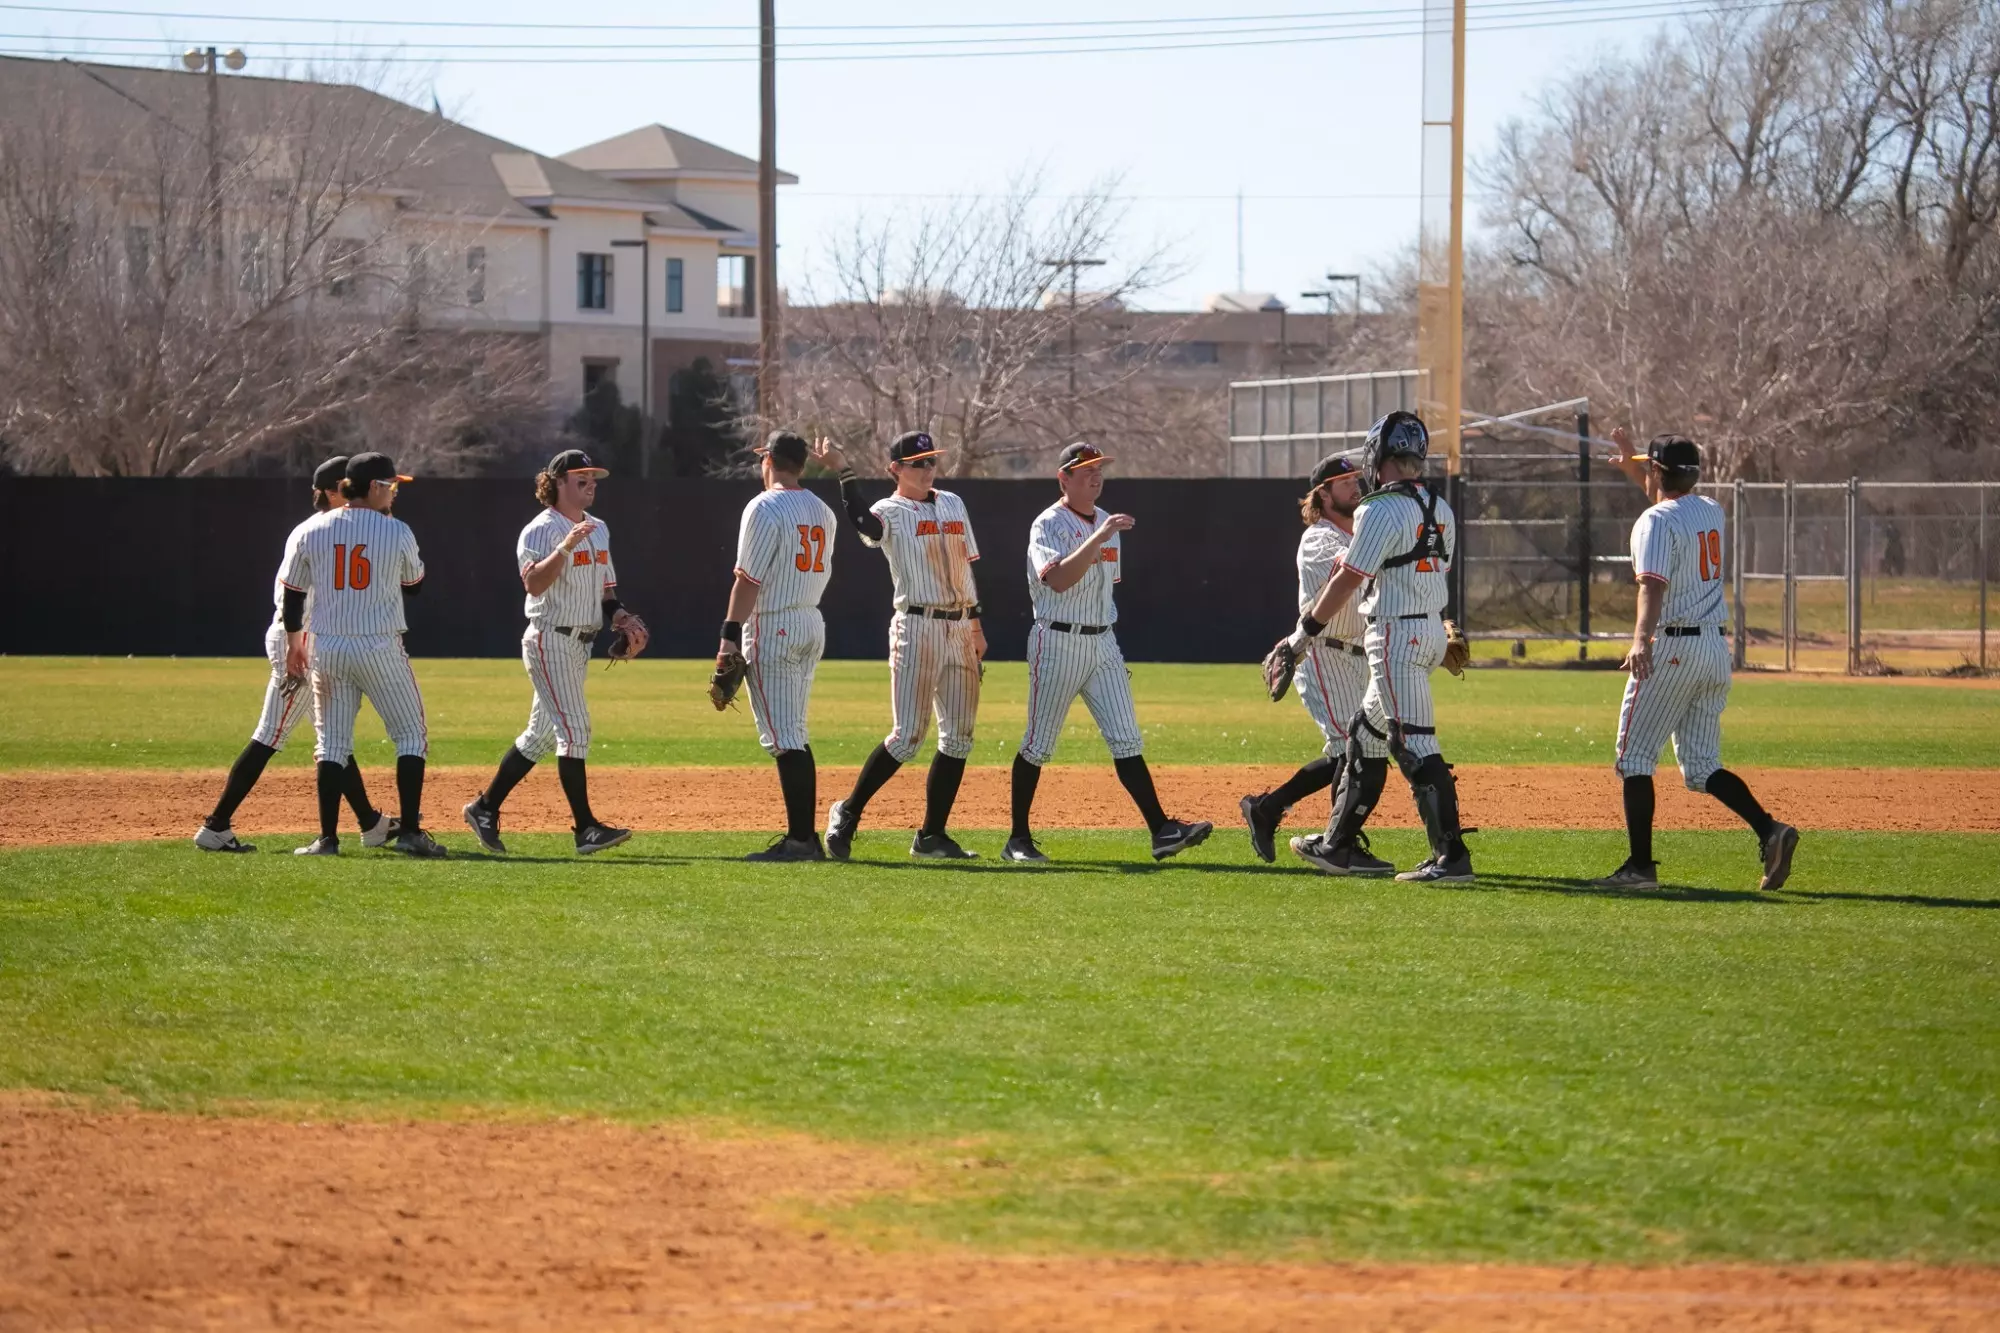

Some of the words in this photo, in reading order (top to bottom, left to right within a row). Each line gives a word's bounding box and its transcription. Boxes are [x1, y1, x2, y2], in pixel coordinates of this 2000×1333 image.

[333, 544, 370, 590] 16
[795, 524, 825, 572] 32
[1697, 528, 1721, 581] 19
